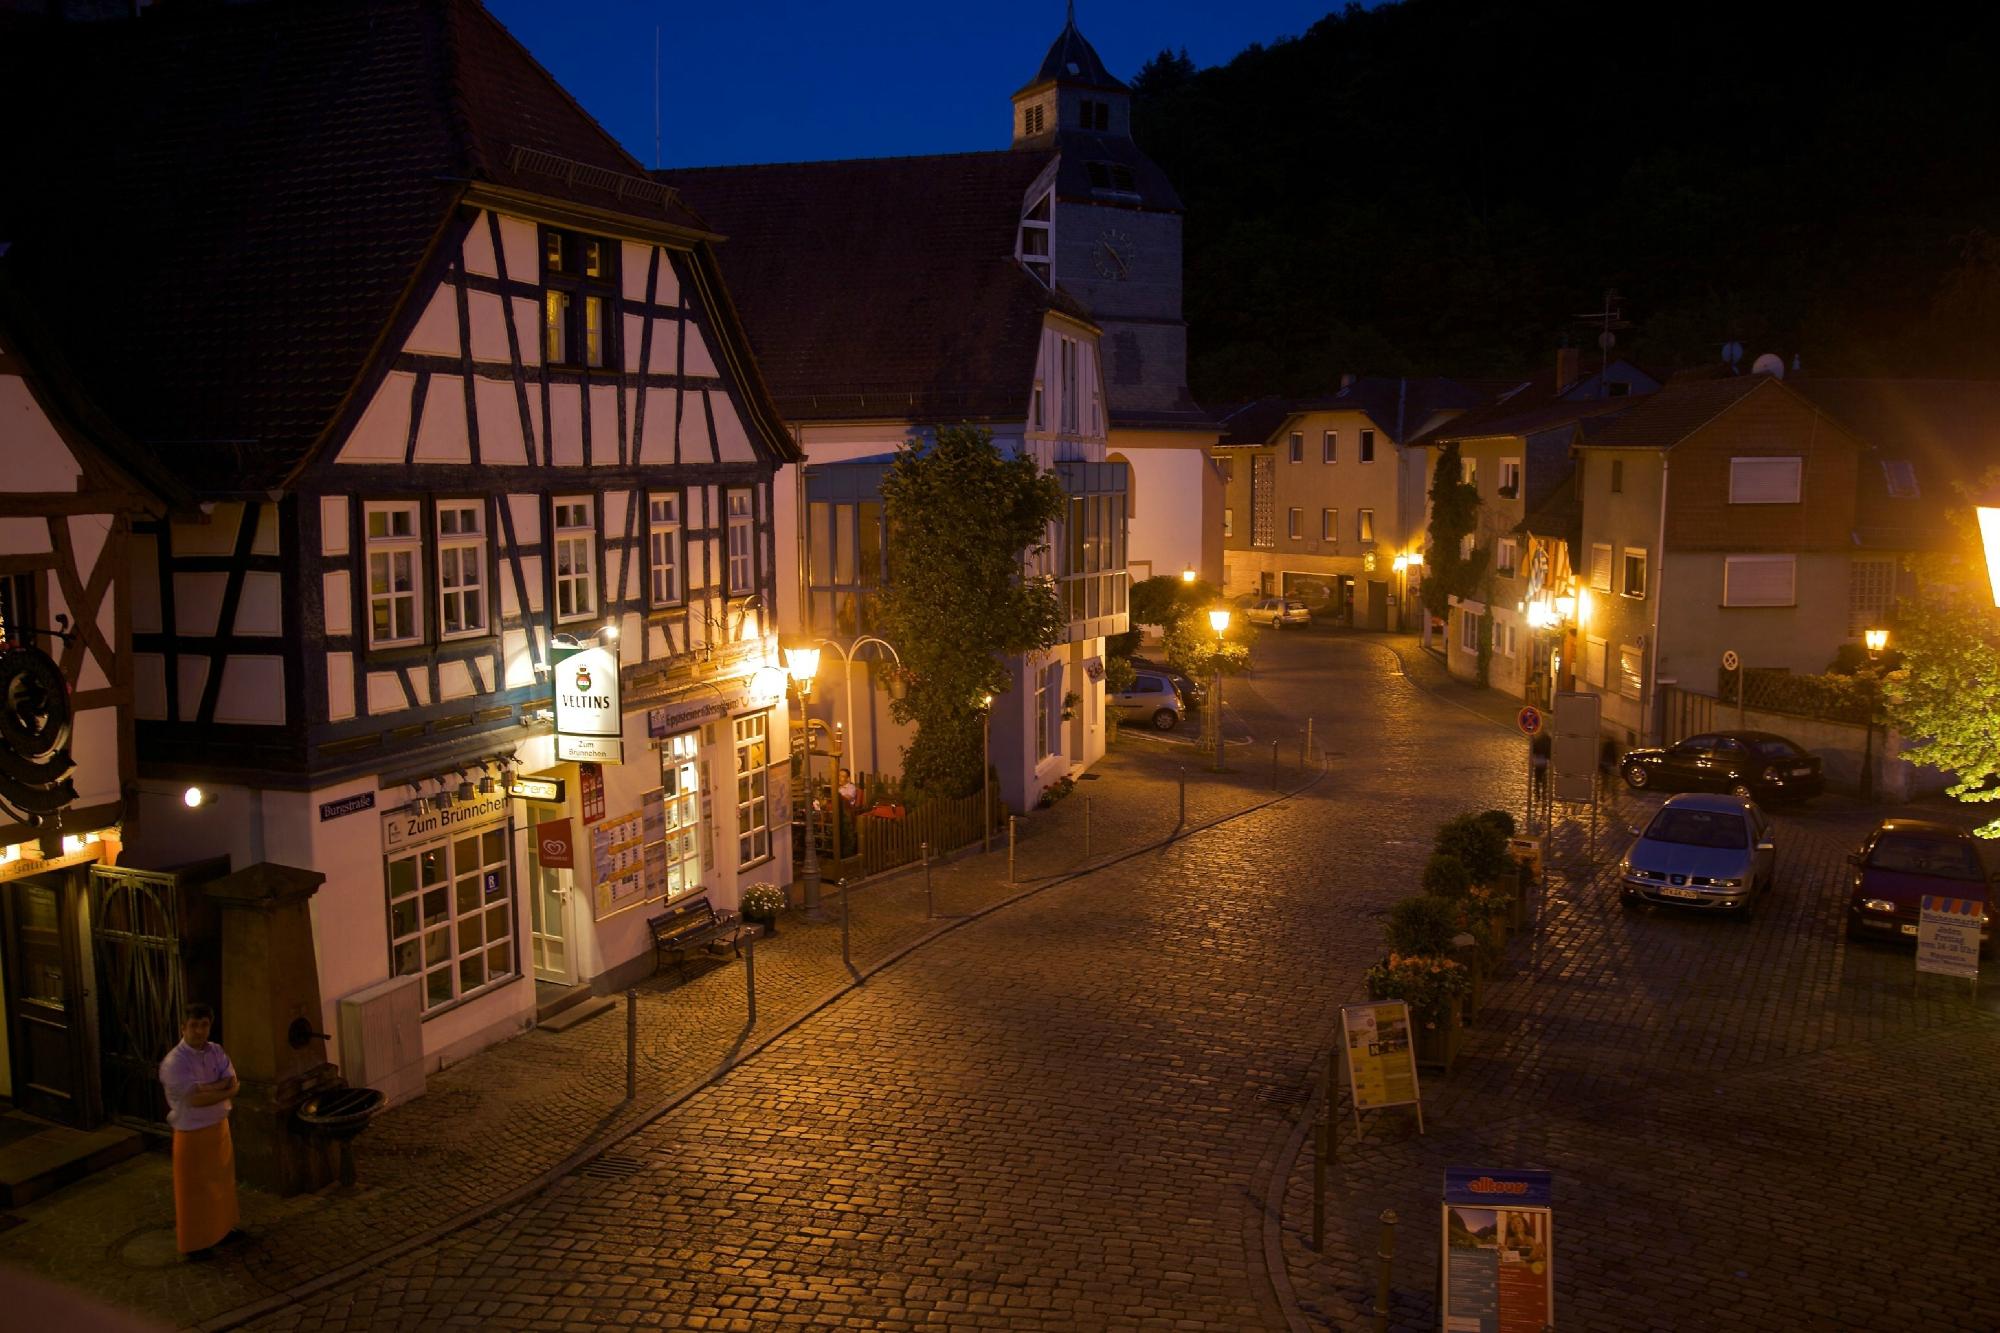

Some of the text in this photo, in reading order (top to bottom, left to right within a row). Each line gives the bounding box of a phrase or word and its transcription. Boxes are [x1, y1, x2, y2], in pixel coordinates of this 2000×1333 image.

[562, 693, 610, 709] VELTINS
[578, 740, 594, 748] Zum
[568, 748, 607, 758] Brünnchen
[324, 795, 371, 817] Burgstraße
[408, 796, 509, 837] Zum Brünnchen
